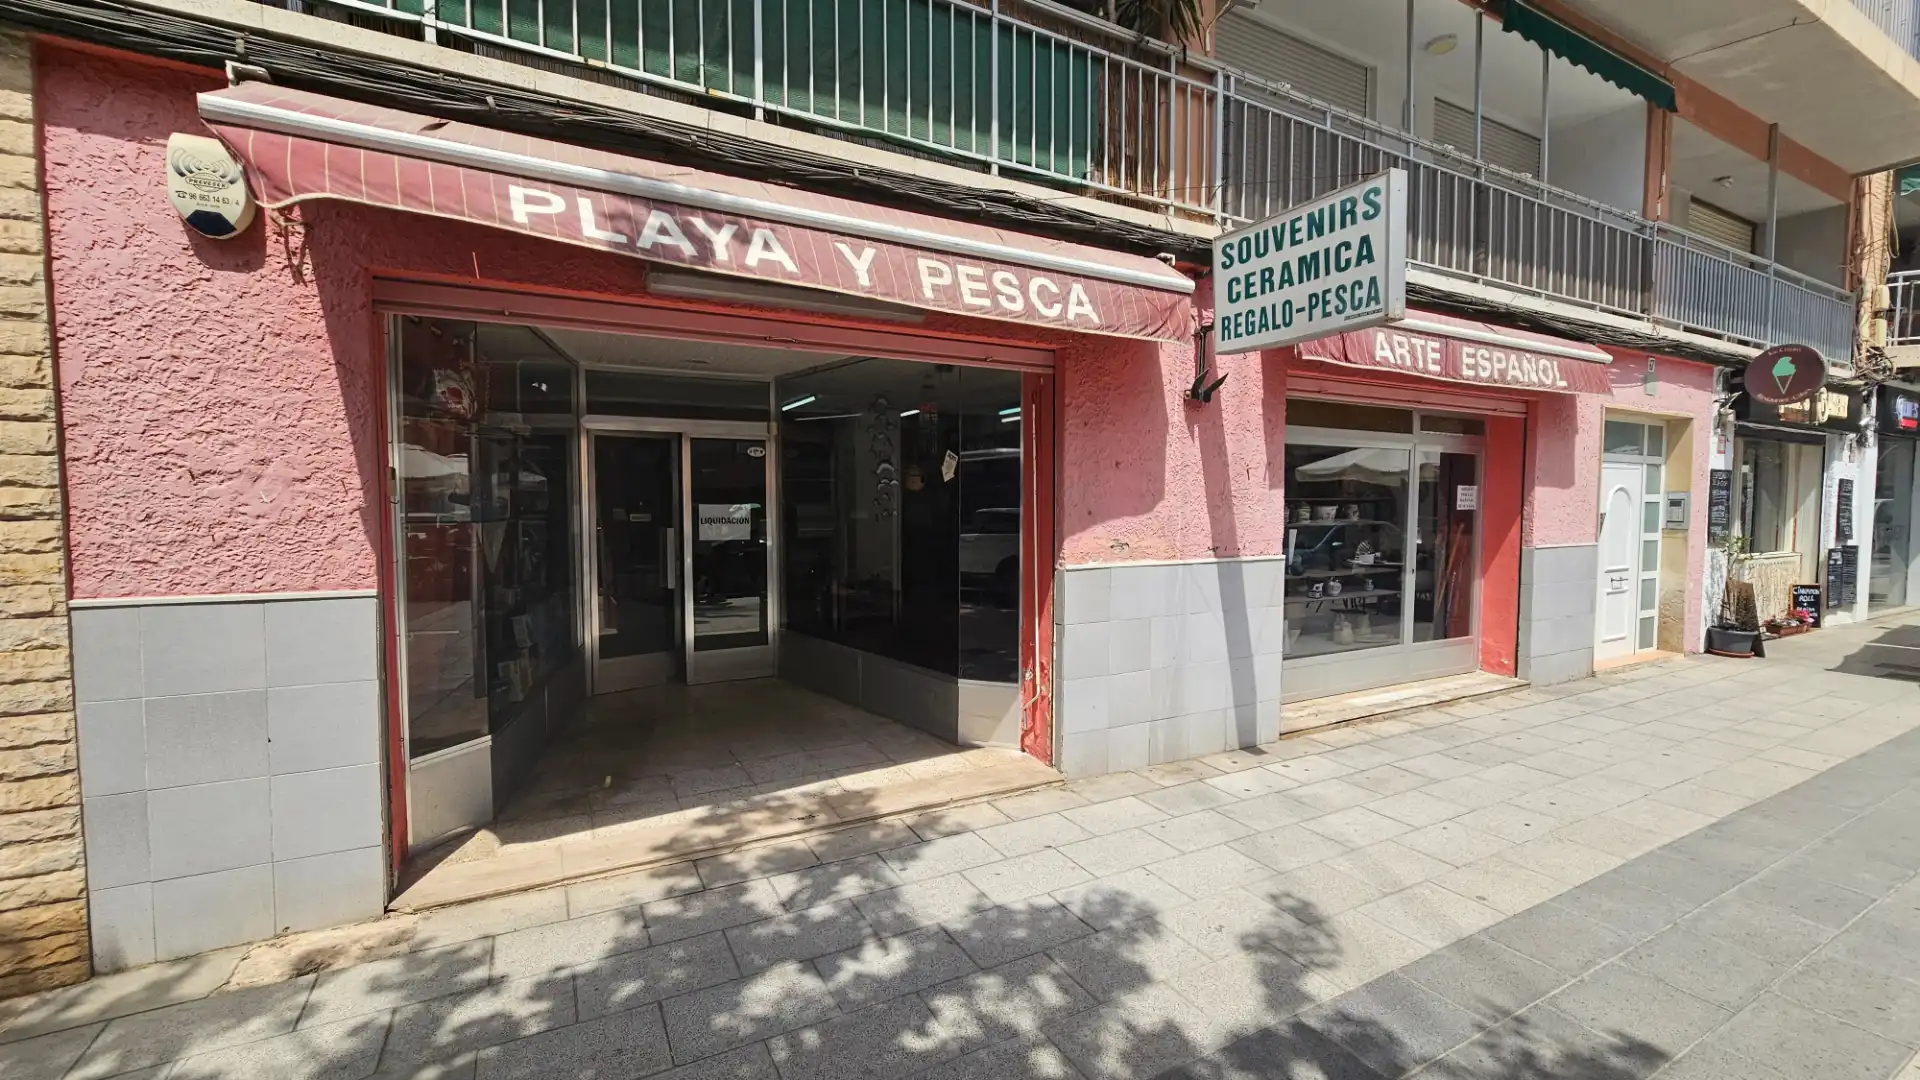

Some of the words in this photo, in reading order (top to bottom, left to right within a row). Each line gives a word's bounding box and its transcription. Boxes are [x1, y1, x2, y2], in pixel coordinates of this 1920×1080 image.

[508, 184, 799, 273] PLAYA
[835, 242, 876, 287] Y
[917, 258, 1100, 323] PESCA
[1221, 186, 1382, 270] SOUVENIRS
[1227, 234, 1375, 304] CERAMICA
[1221, 275, 1381, 341] REGALO-PESCA
[1375, 331, 1441, 373] ARTE
[1461, 346, 1568, 387] ESPAÑOL
[700, 515, 750, 526] LIQUIDACIÓN
